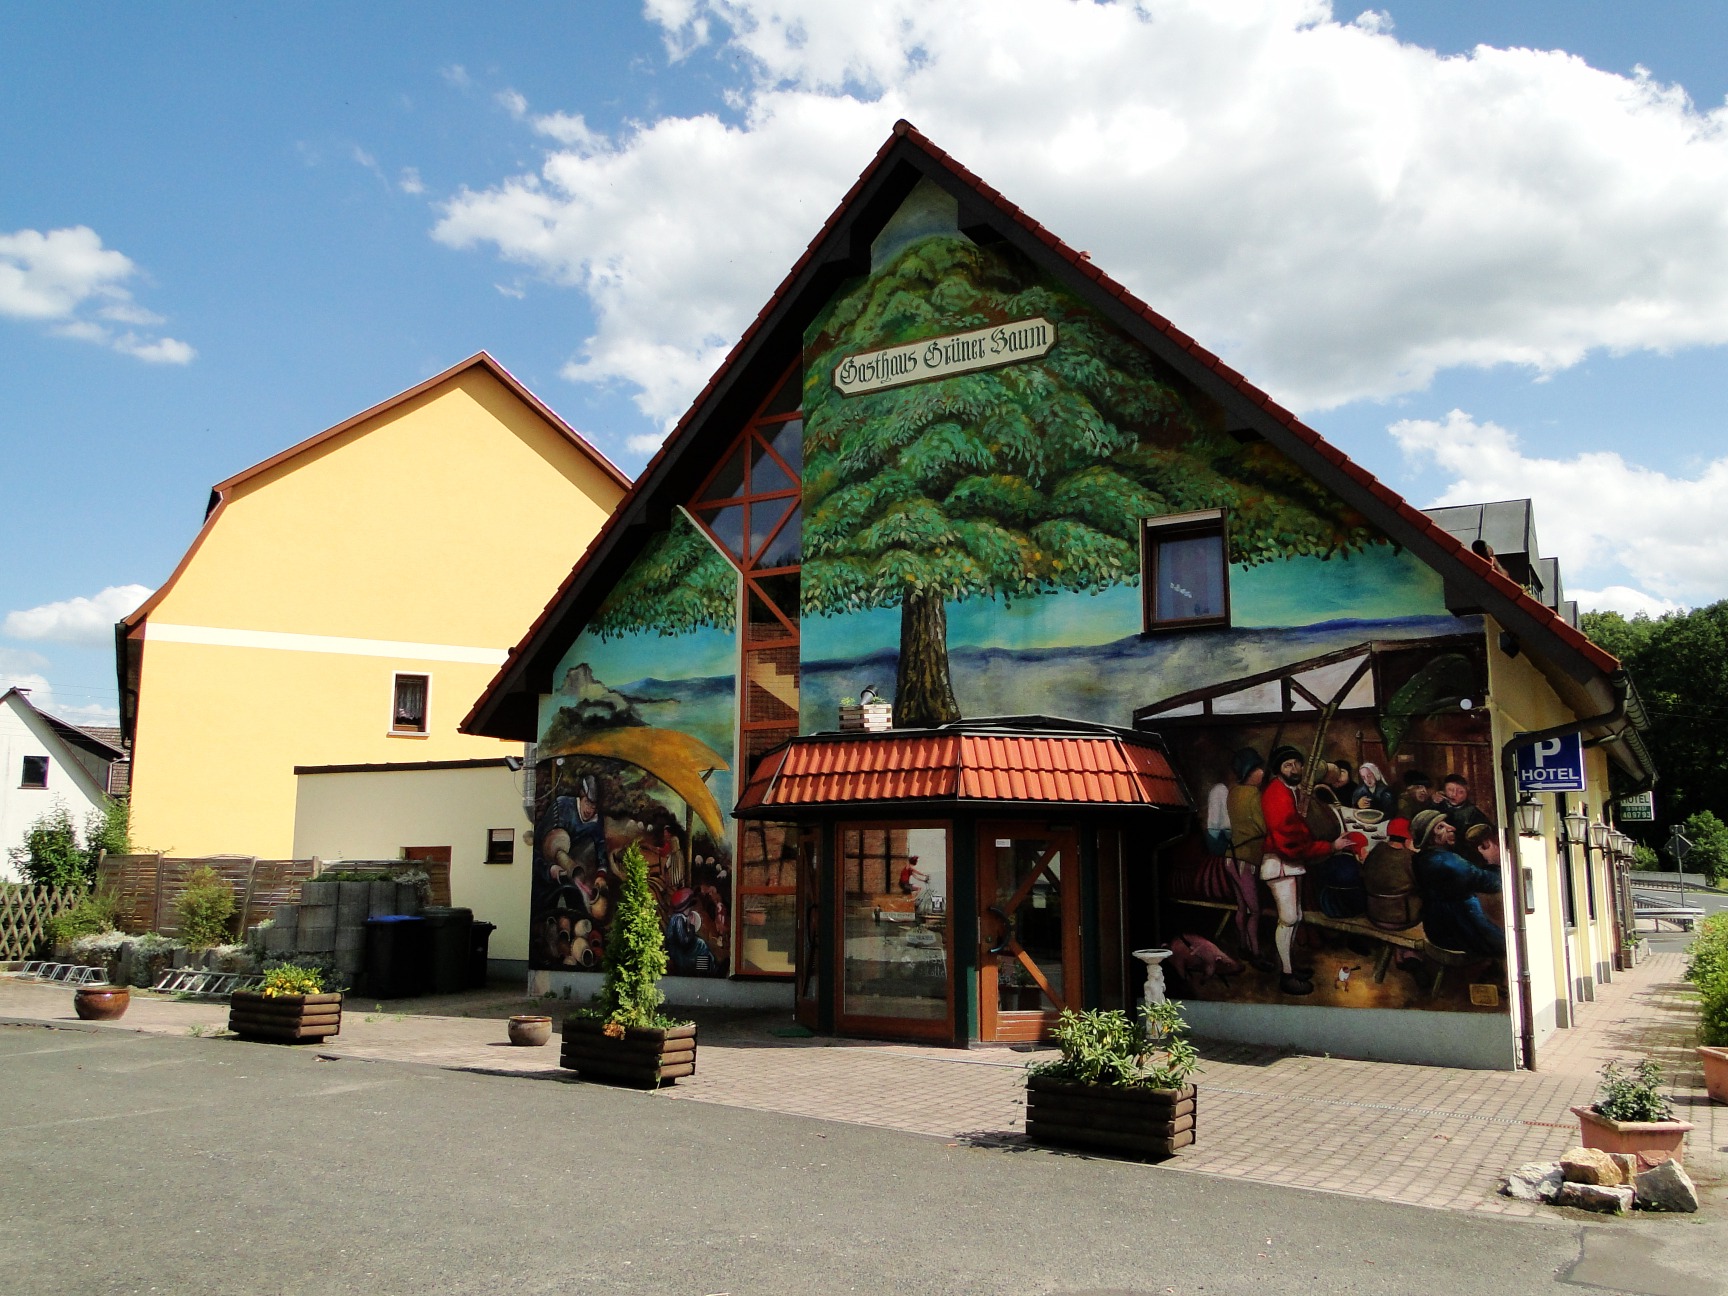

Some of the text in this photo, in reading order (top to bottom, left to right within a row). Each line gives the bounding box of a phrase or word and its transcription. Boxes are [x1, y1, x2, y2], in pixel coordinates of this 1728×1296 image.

[840, 324, 1048, 385] Gasthaus Grüner Baum
[1534, 737, 1562, 768] P
[1521, 767, 1580, 781] HOTEL
